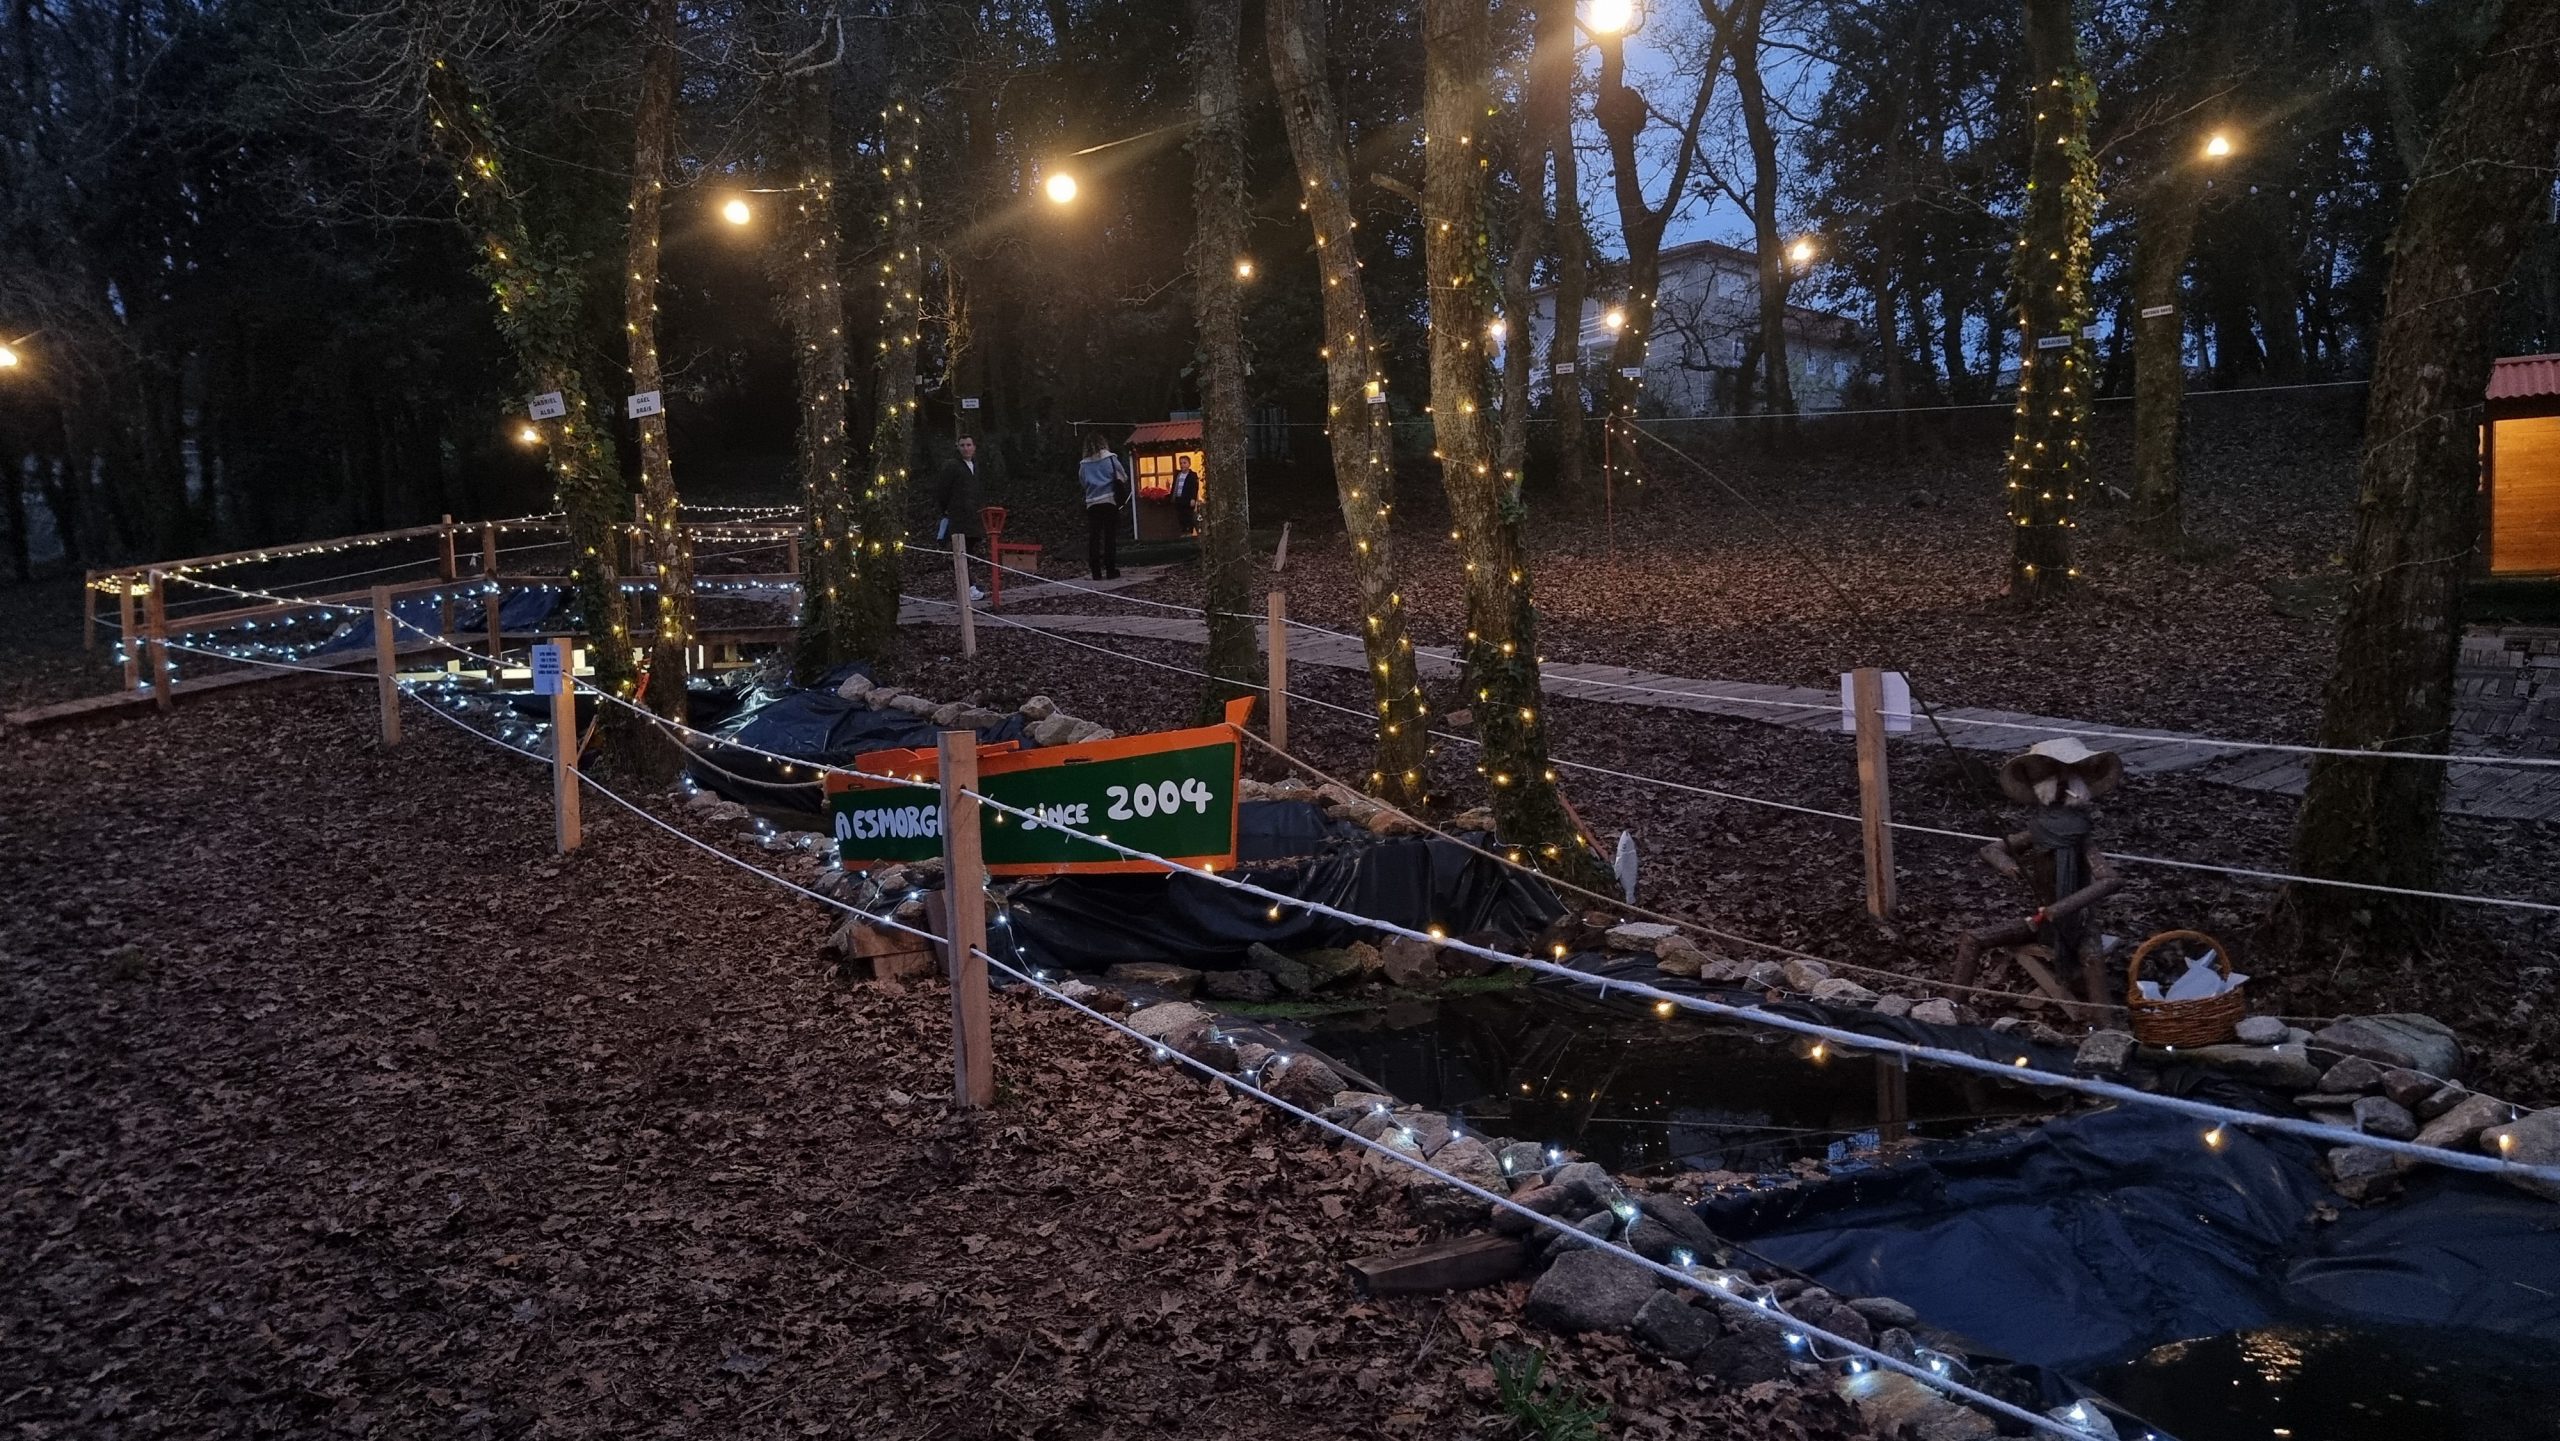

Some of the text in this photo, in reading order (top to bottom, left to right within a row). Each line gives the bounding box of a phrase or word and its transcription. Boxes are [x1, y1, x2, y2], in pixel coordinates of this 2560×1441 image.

[533, 397, 557, 407] GABRIEL
[835, 811, 852, 841] A
[1106, 778, 1213, 820] 2004
